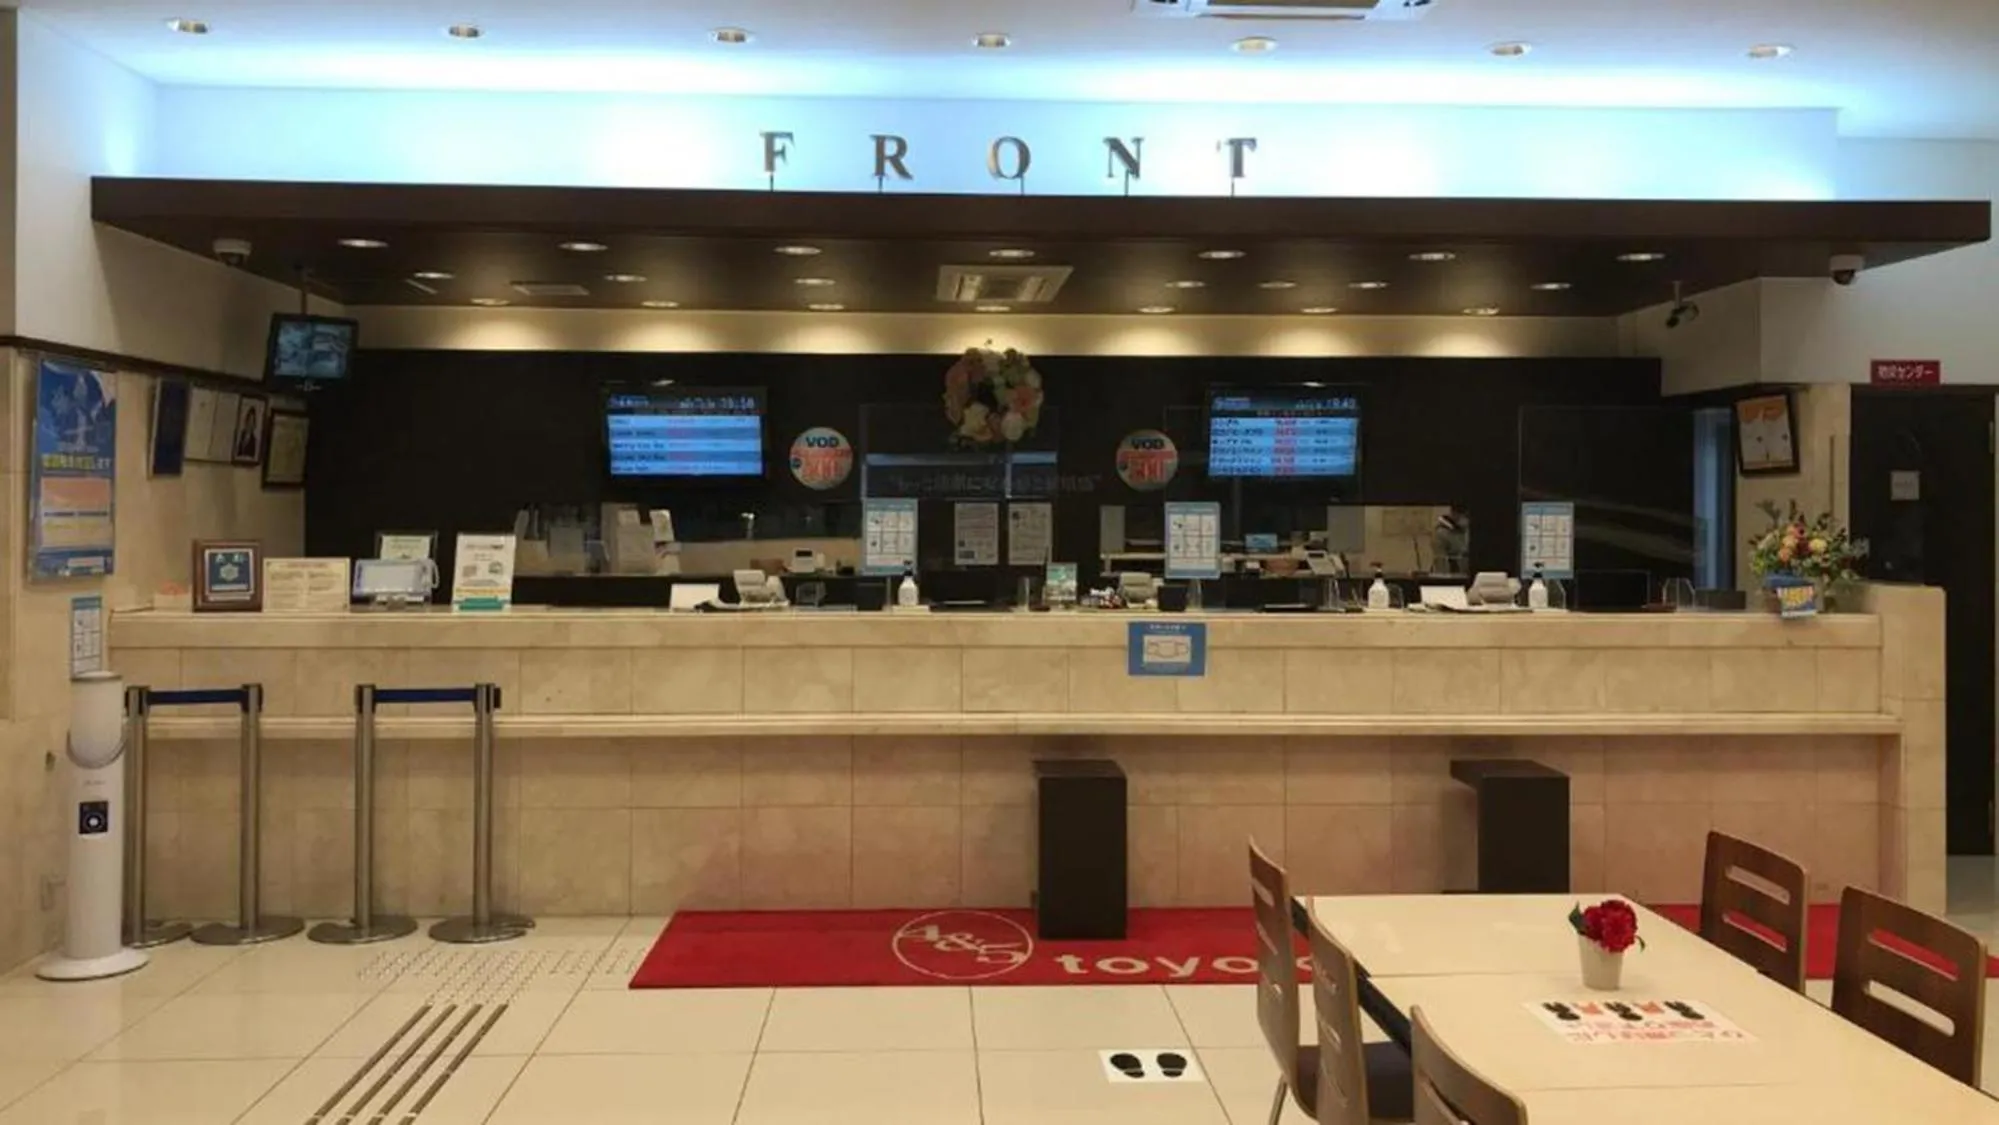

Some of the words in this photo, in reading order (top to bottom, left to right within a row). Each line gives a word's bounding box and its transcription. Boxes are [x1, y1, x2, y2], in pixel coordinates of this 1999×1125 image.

[759, 129, 1258, 180] FRONT
[805, 436, 840, 449] VOD
[1130, 438, 1165, 450] VOD
